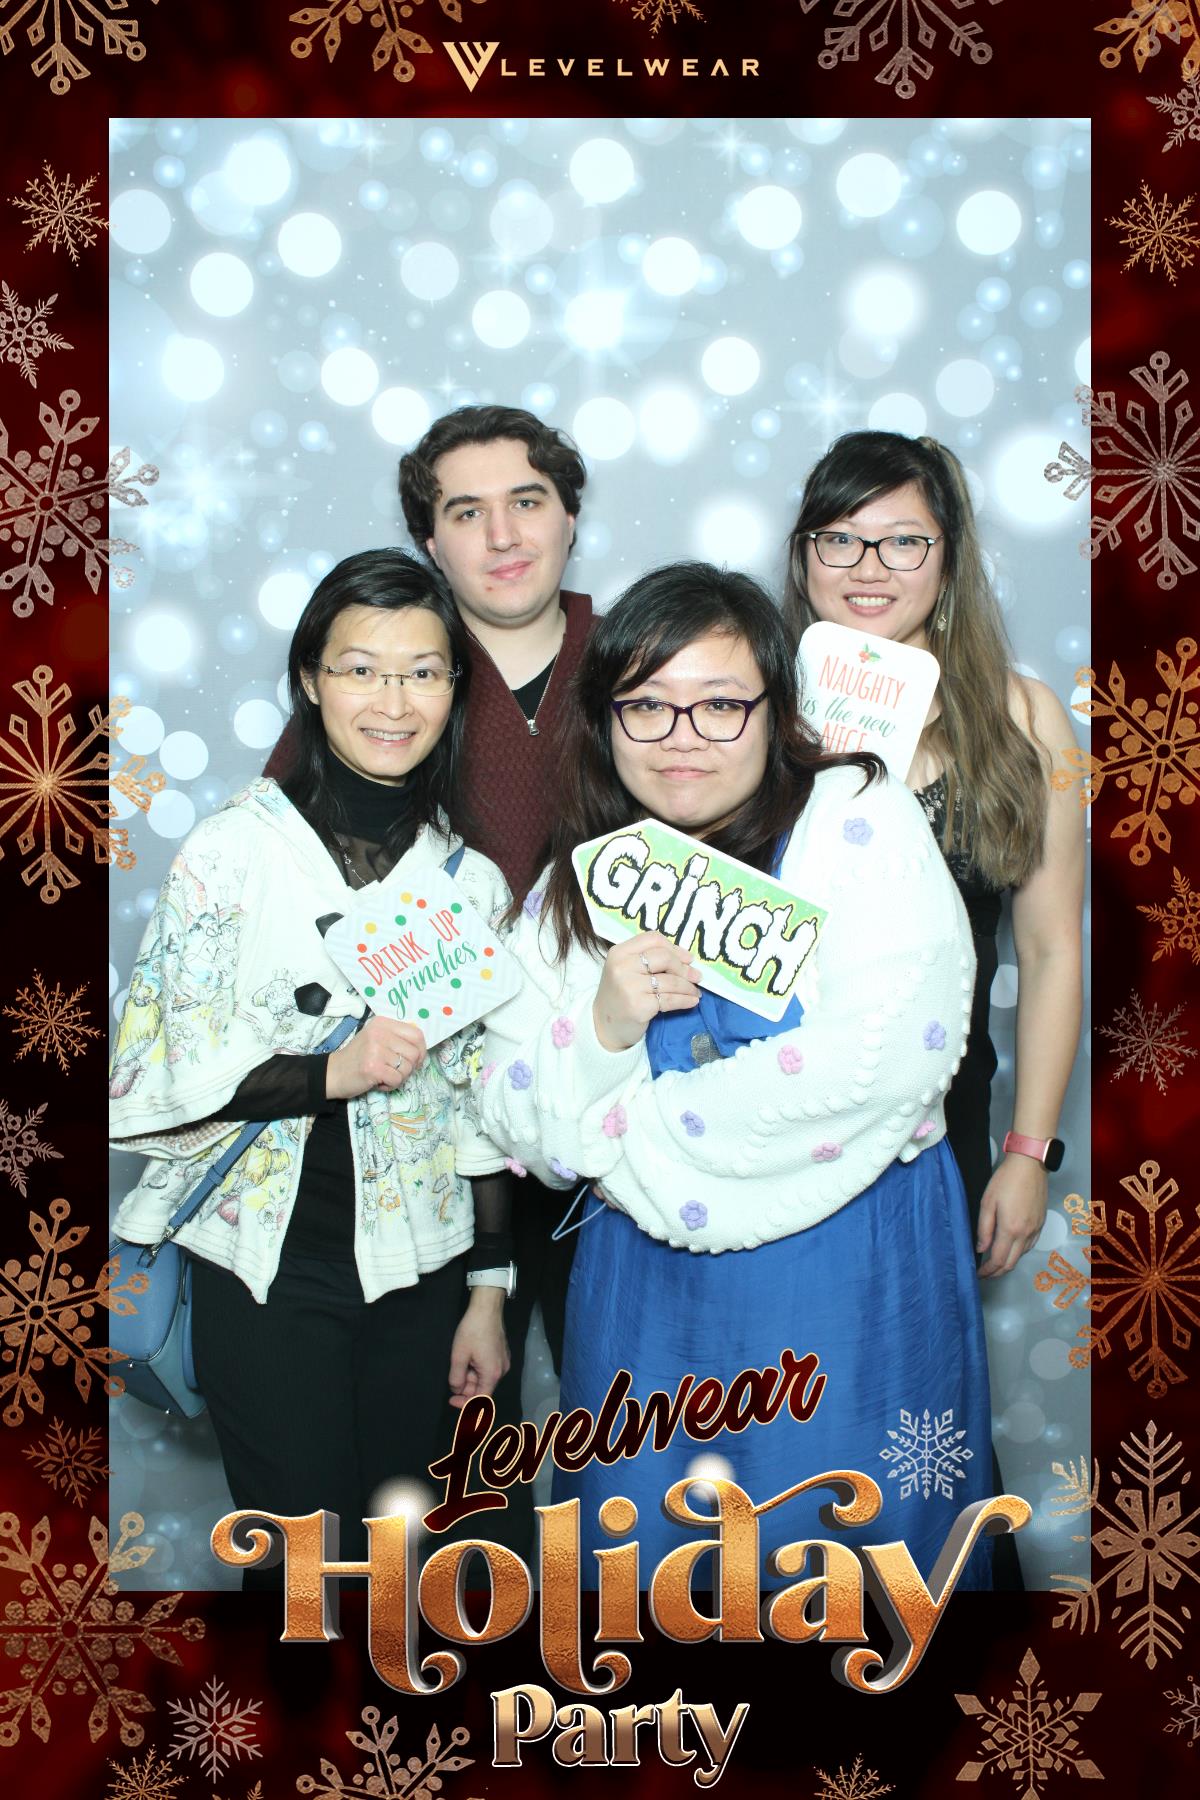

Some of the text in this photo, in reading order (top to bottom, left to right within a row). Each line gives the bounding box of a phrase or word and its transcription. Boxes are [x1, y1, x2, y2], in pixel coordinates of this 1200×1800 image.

[818, 654, 906, 710] NAUGHTY
[803, 697, 896, 738] is the new
[821, 721, 868, 753] NICE
[357, 909, 461, 986] DRINK UP
[387, 938, 478, 1020] grinches
